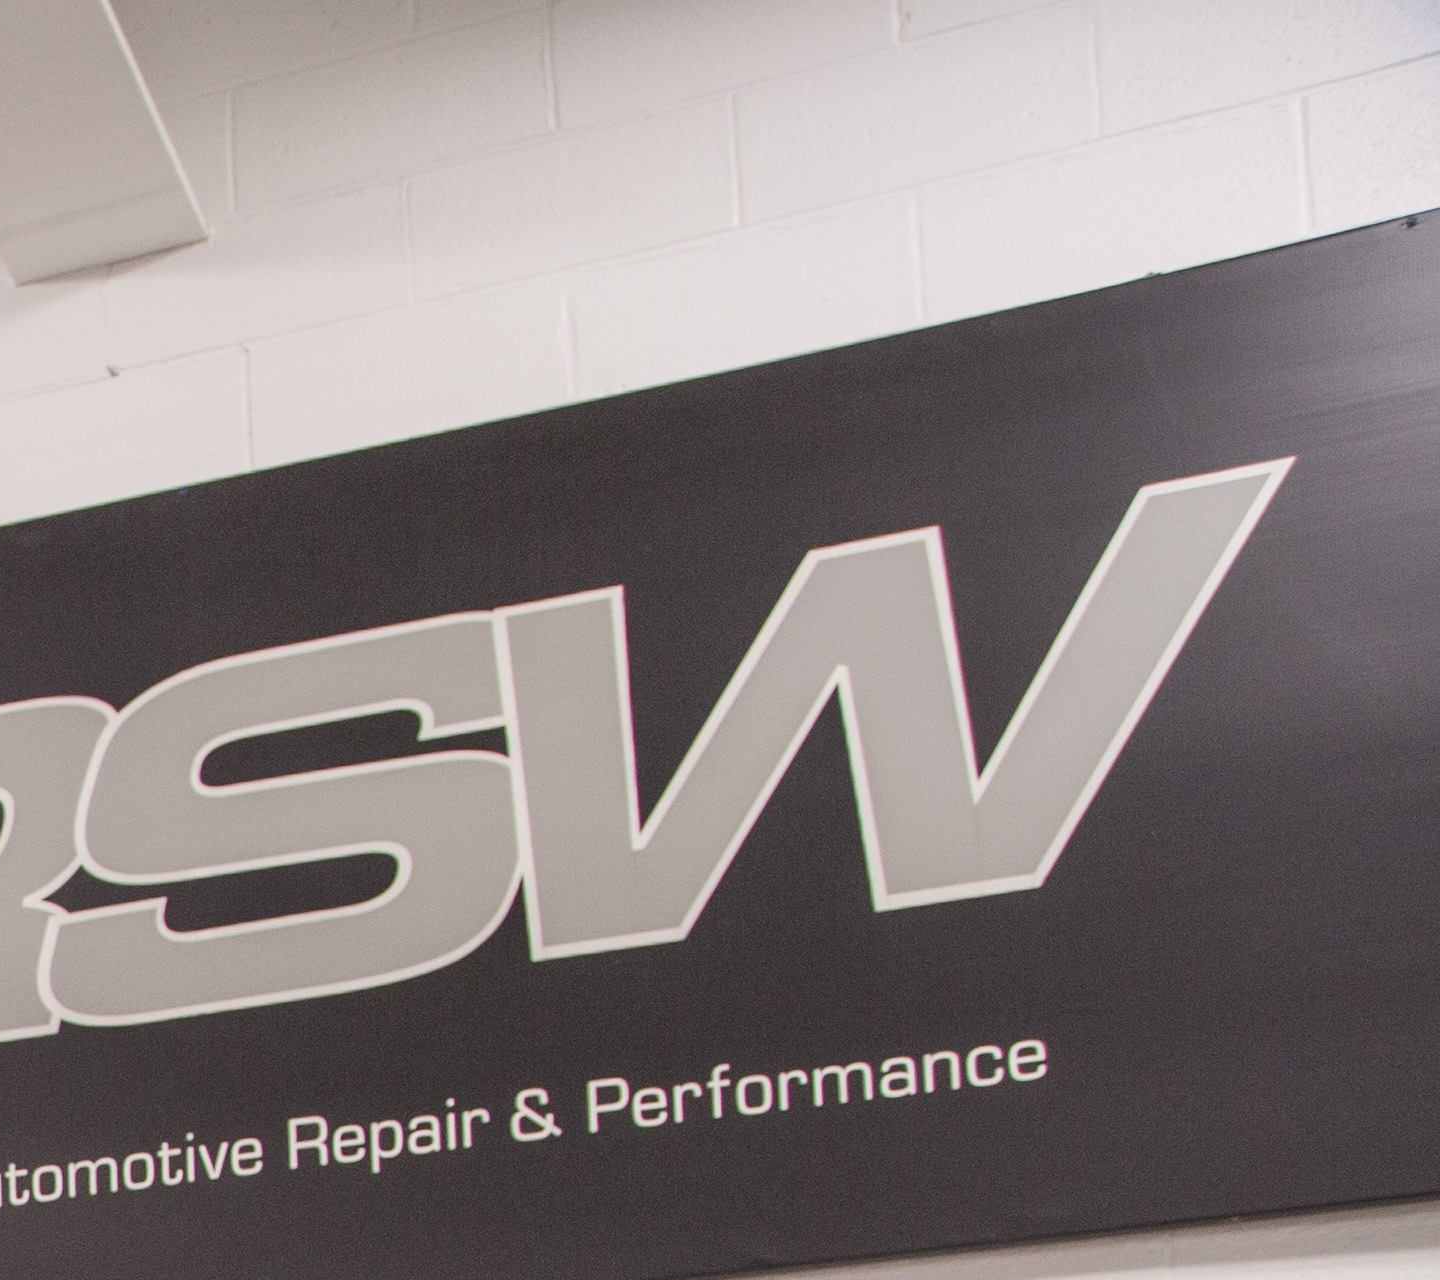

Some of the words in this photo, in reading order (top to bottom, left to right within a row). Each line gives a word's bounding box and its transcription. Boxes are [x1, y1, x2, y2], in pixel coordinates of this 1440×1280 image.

[288, 1107, 490, 1174] Repair
[510, 1088, 562, 1142] &
[587, 1039, 1047, 1133] Performance
